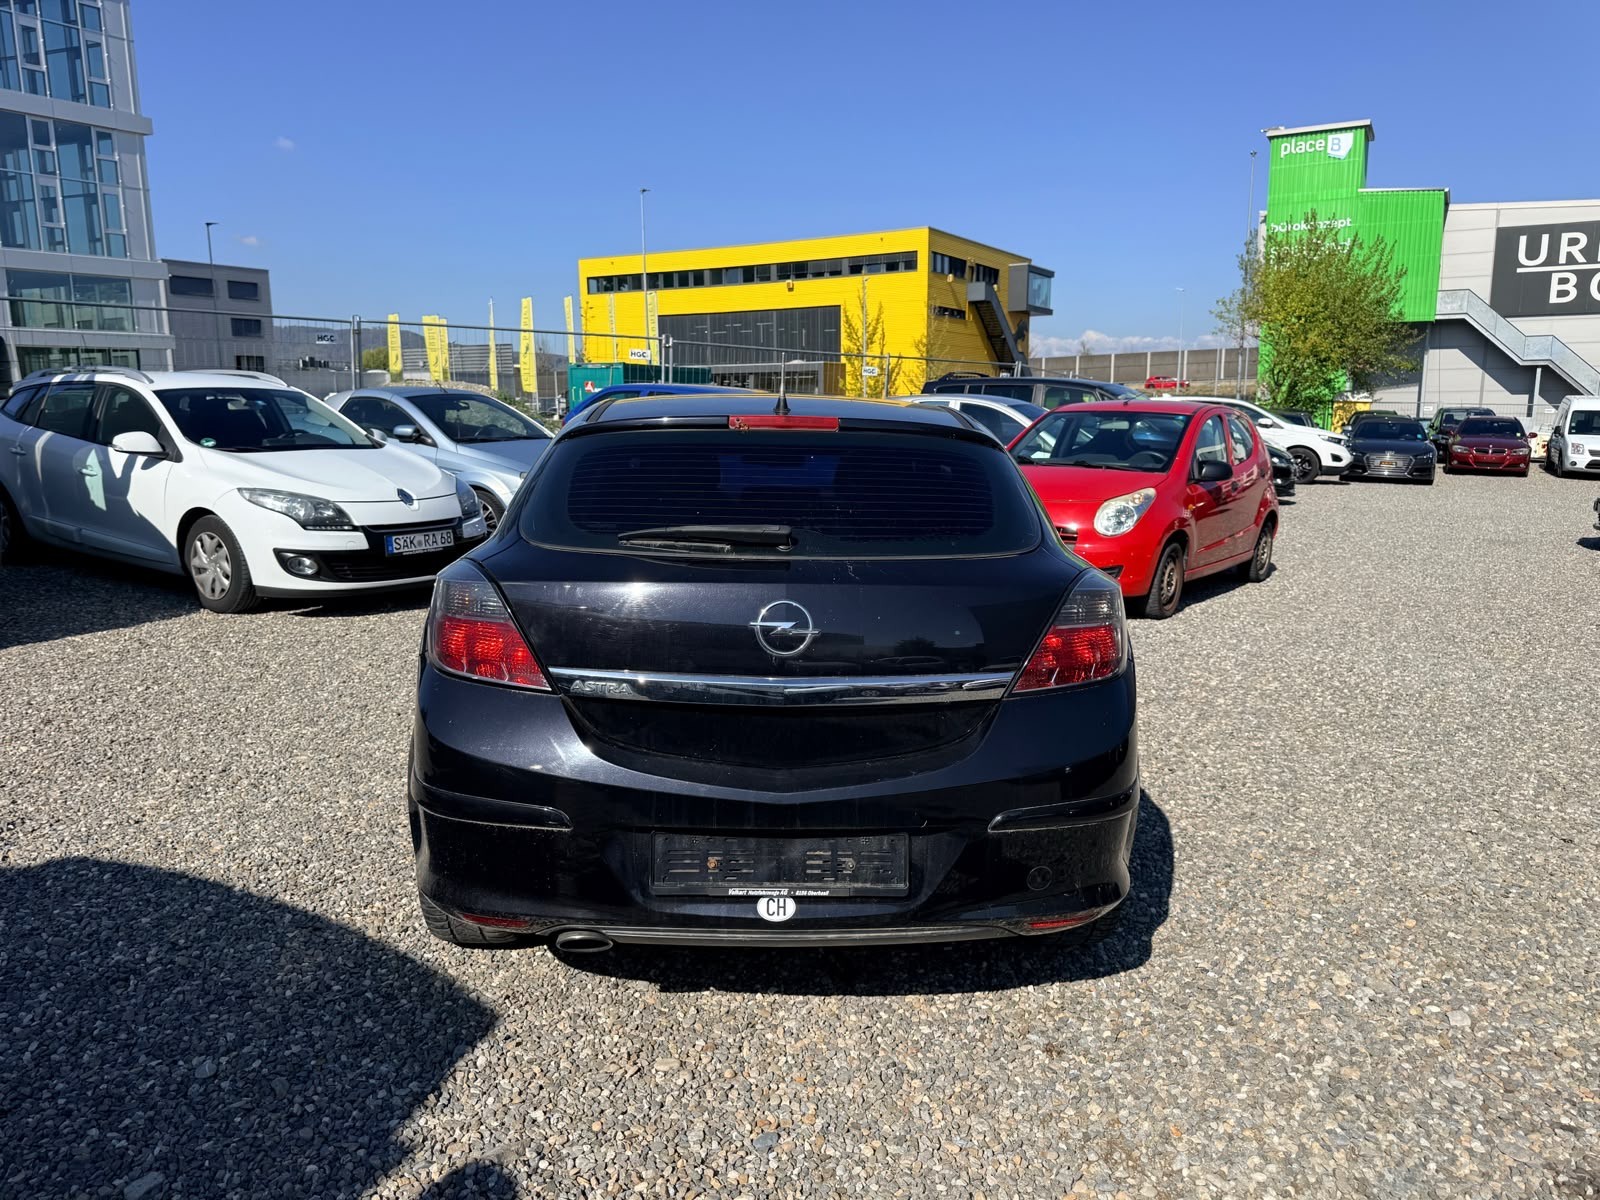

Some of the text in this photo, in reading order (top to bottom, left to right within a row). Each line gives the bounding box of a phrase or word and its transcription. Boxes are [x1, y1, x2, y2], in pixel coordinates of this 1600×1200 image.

[1280, 138, 1326, 159] place
[1518, 232, 1600, 266] UR
[317, 334, 335, 342] HGC
[394, 535, 417, 551] SÄK
[423, 533, 439, 547] RA
[440, 531, 452, 544] 68
[570, 680, 633, 695] ASTRA
[766, 897, 787, 917] CH
